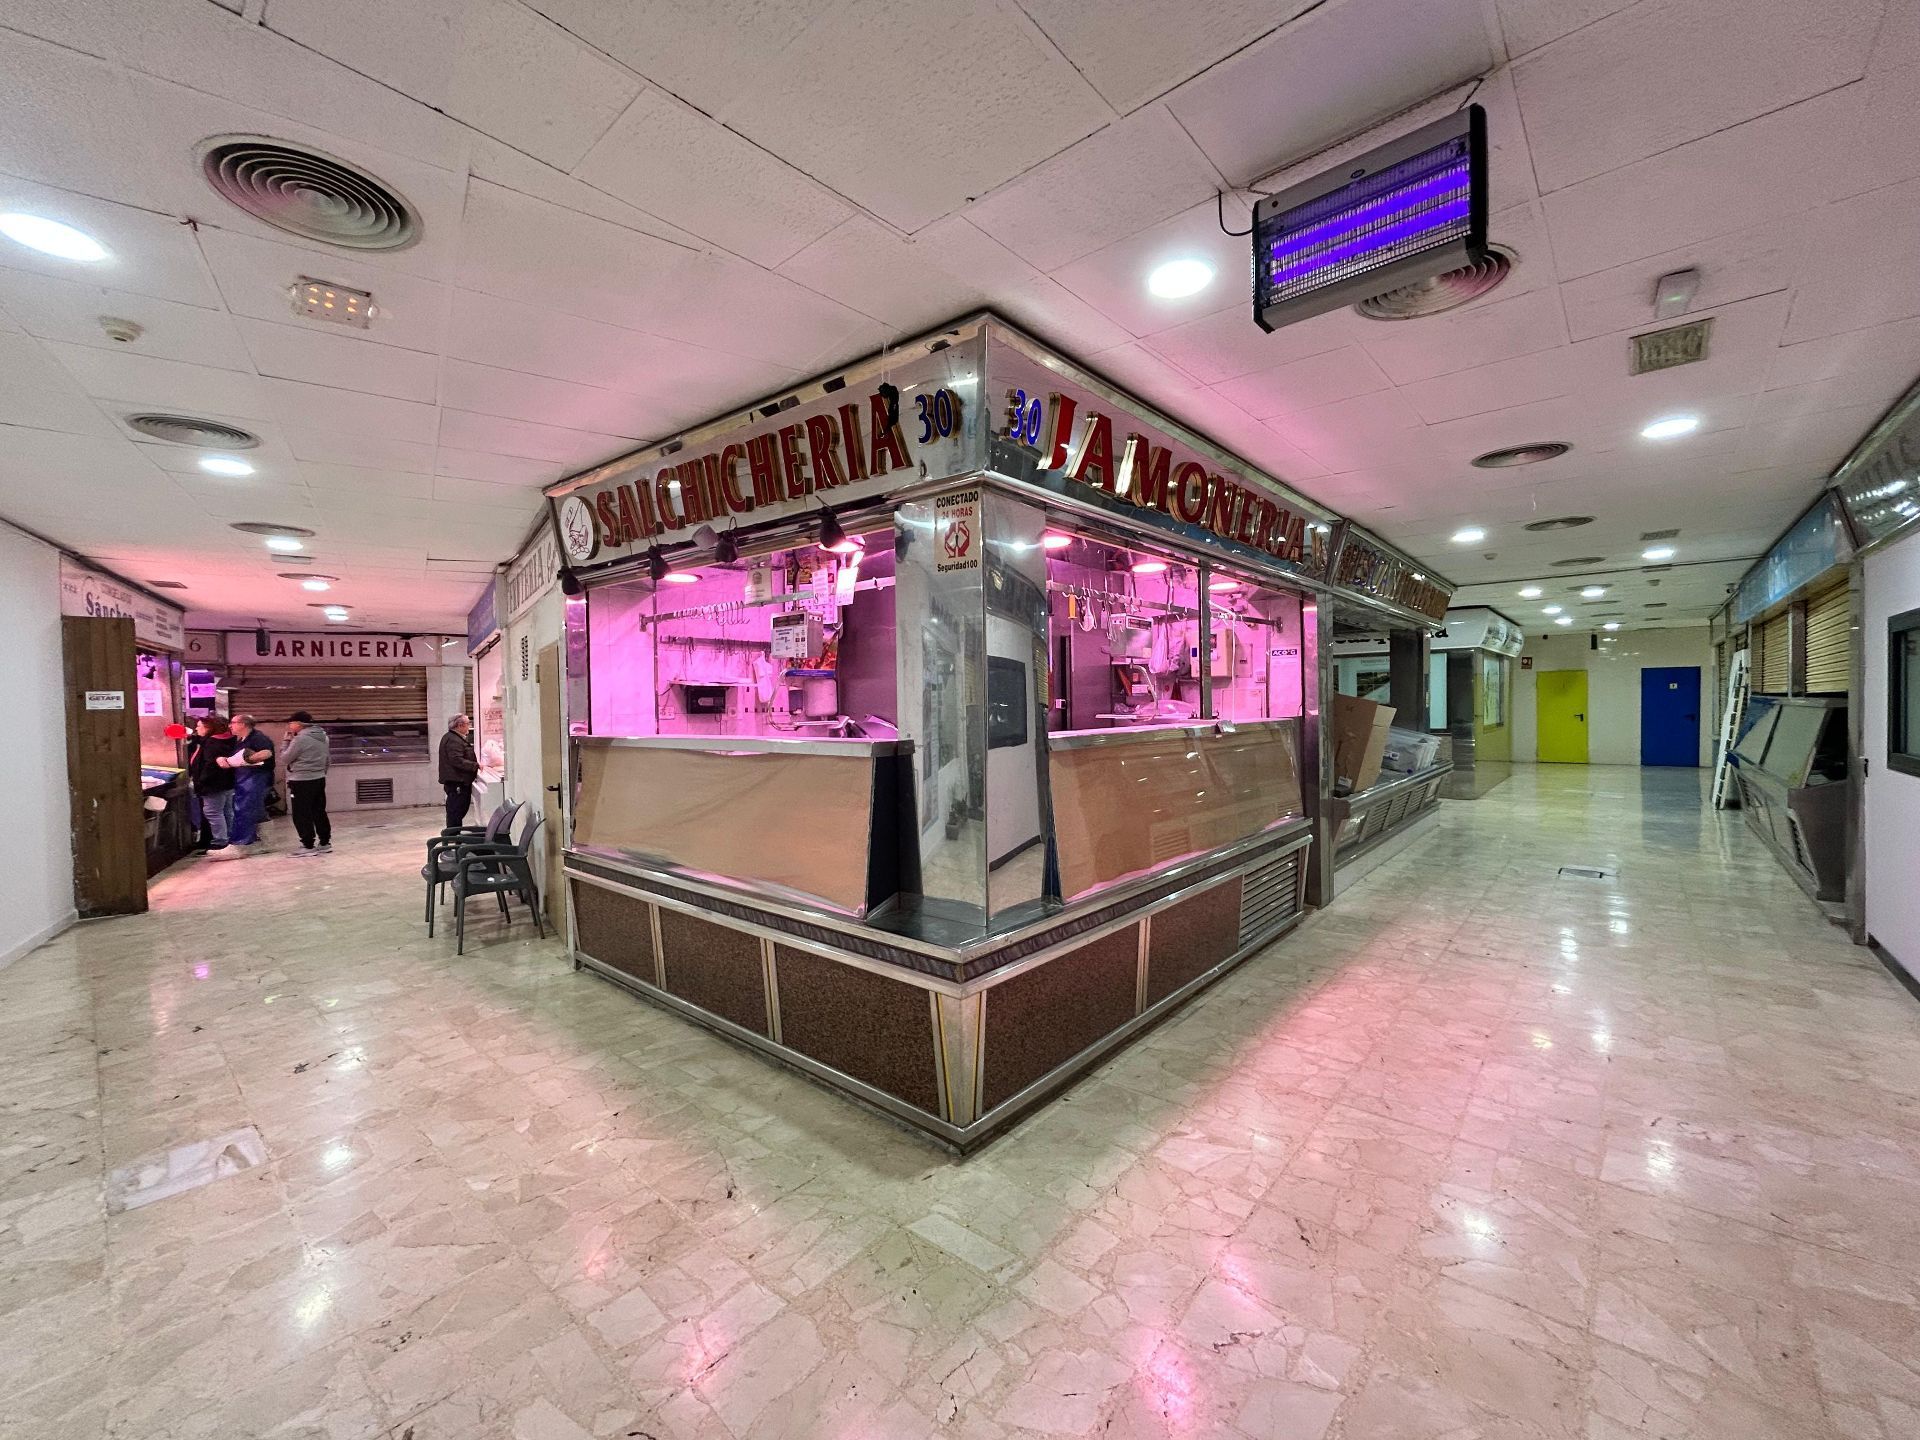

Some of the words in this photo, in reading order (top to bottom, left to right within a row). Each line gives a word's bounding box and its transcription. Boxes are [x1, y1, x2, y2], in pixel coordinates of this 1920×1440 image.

[913, 387, 961, 446] 30
[1007, 387, 1043, 447] 30
[597, 392, 914, 548] SALCHICHERIA
[1039, 392, 1305, 562] JAMONERIA
[936, 490, 979, 509] CONECTADO
[952, 506, 973, 518] HORAS
[937, 559, 978, 573] Seguridad100
[189, 638, 201, 652] 6
[256, 639, 414, 658] ARNICERIA
